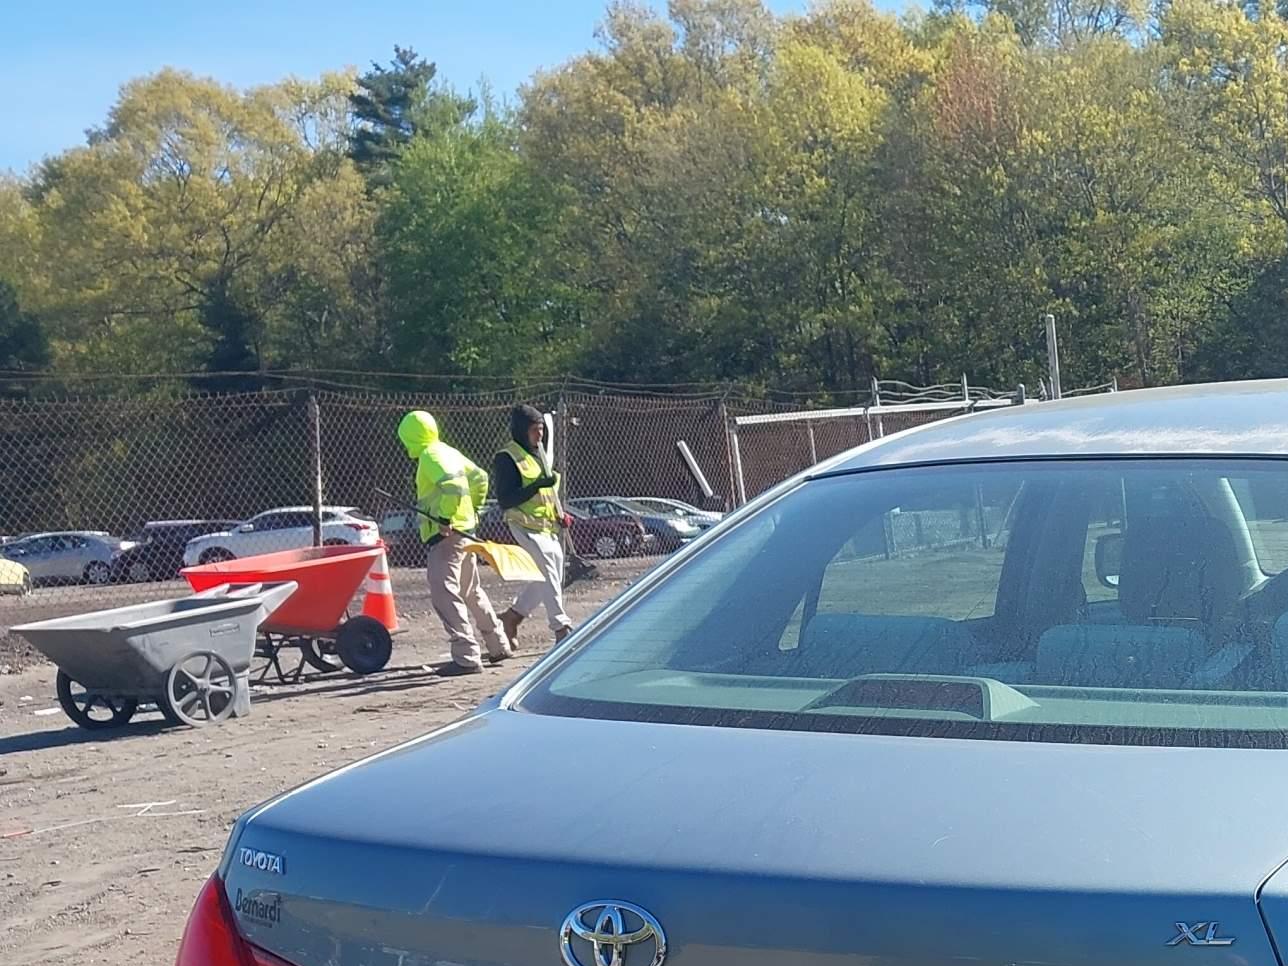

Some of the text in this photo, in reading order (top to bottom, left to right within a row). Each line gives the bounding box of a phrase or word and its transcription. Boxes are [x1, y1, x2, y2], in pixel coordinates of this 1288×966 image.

[240, 847, 282, 873] TOYOTA
[235, 887, 283, 923] Bernardi
[1164, 921, 1237, 945] XL
